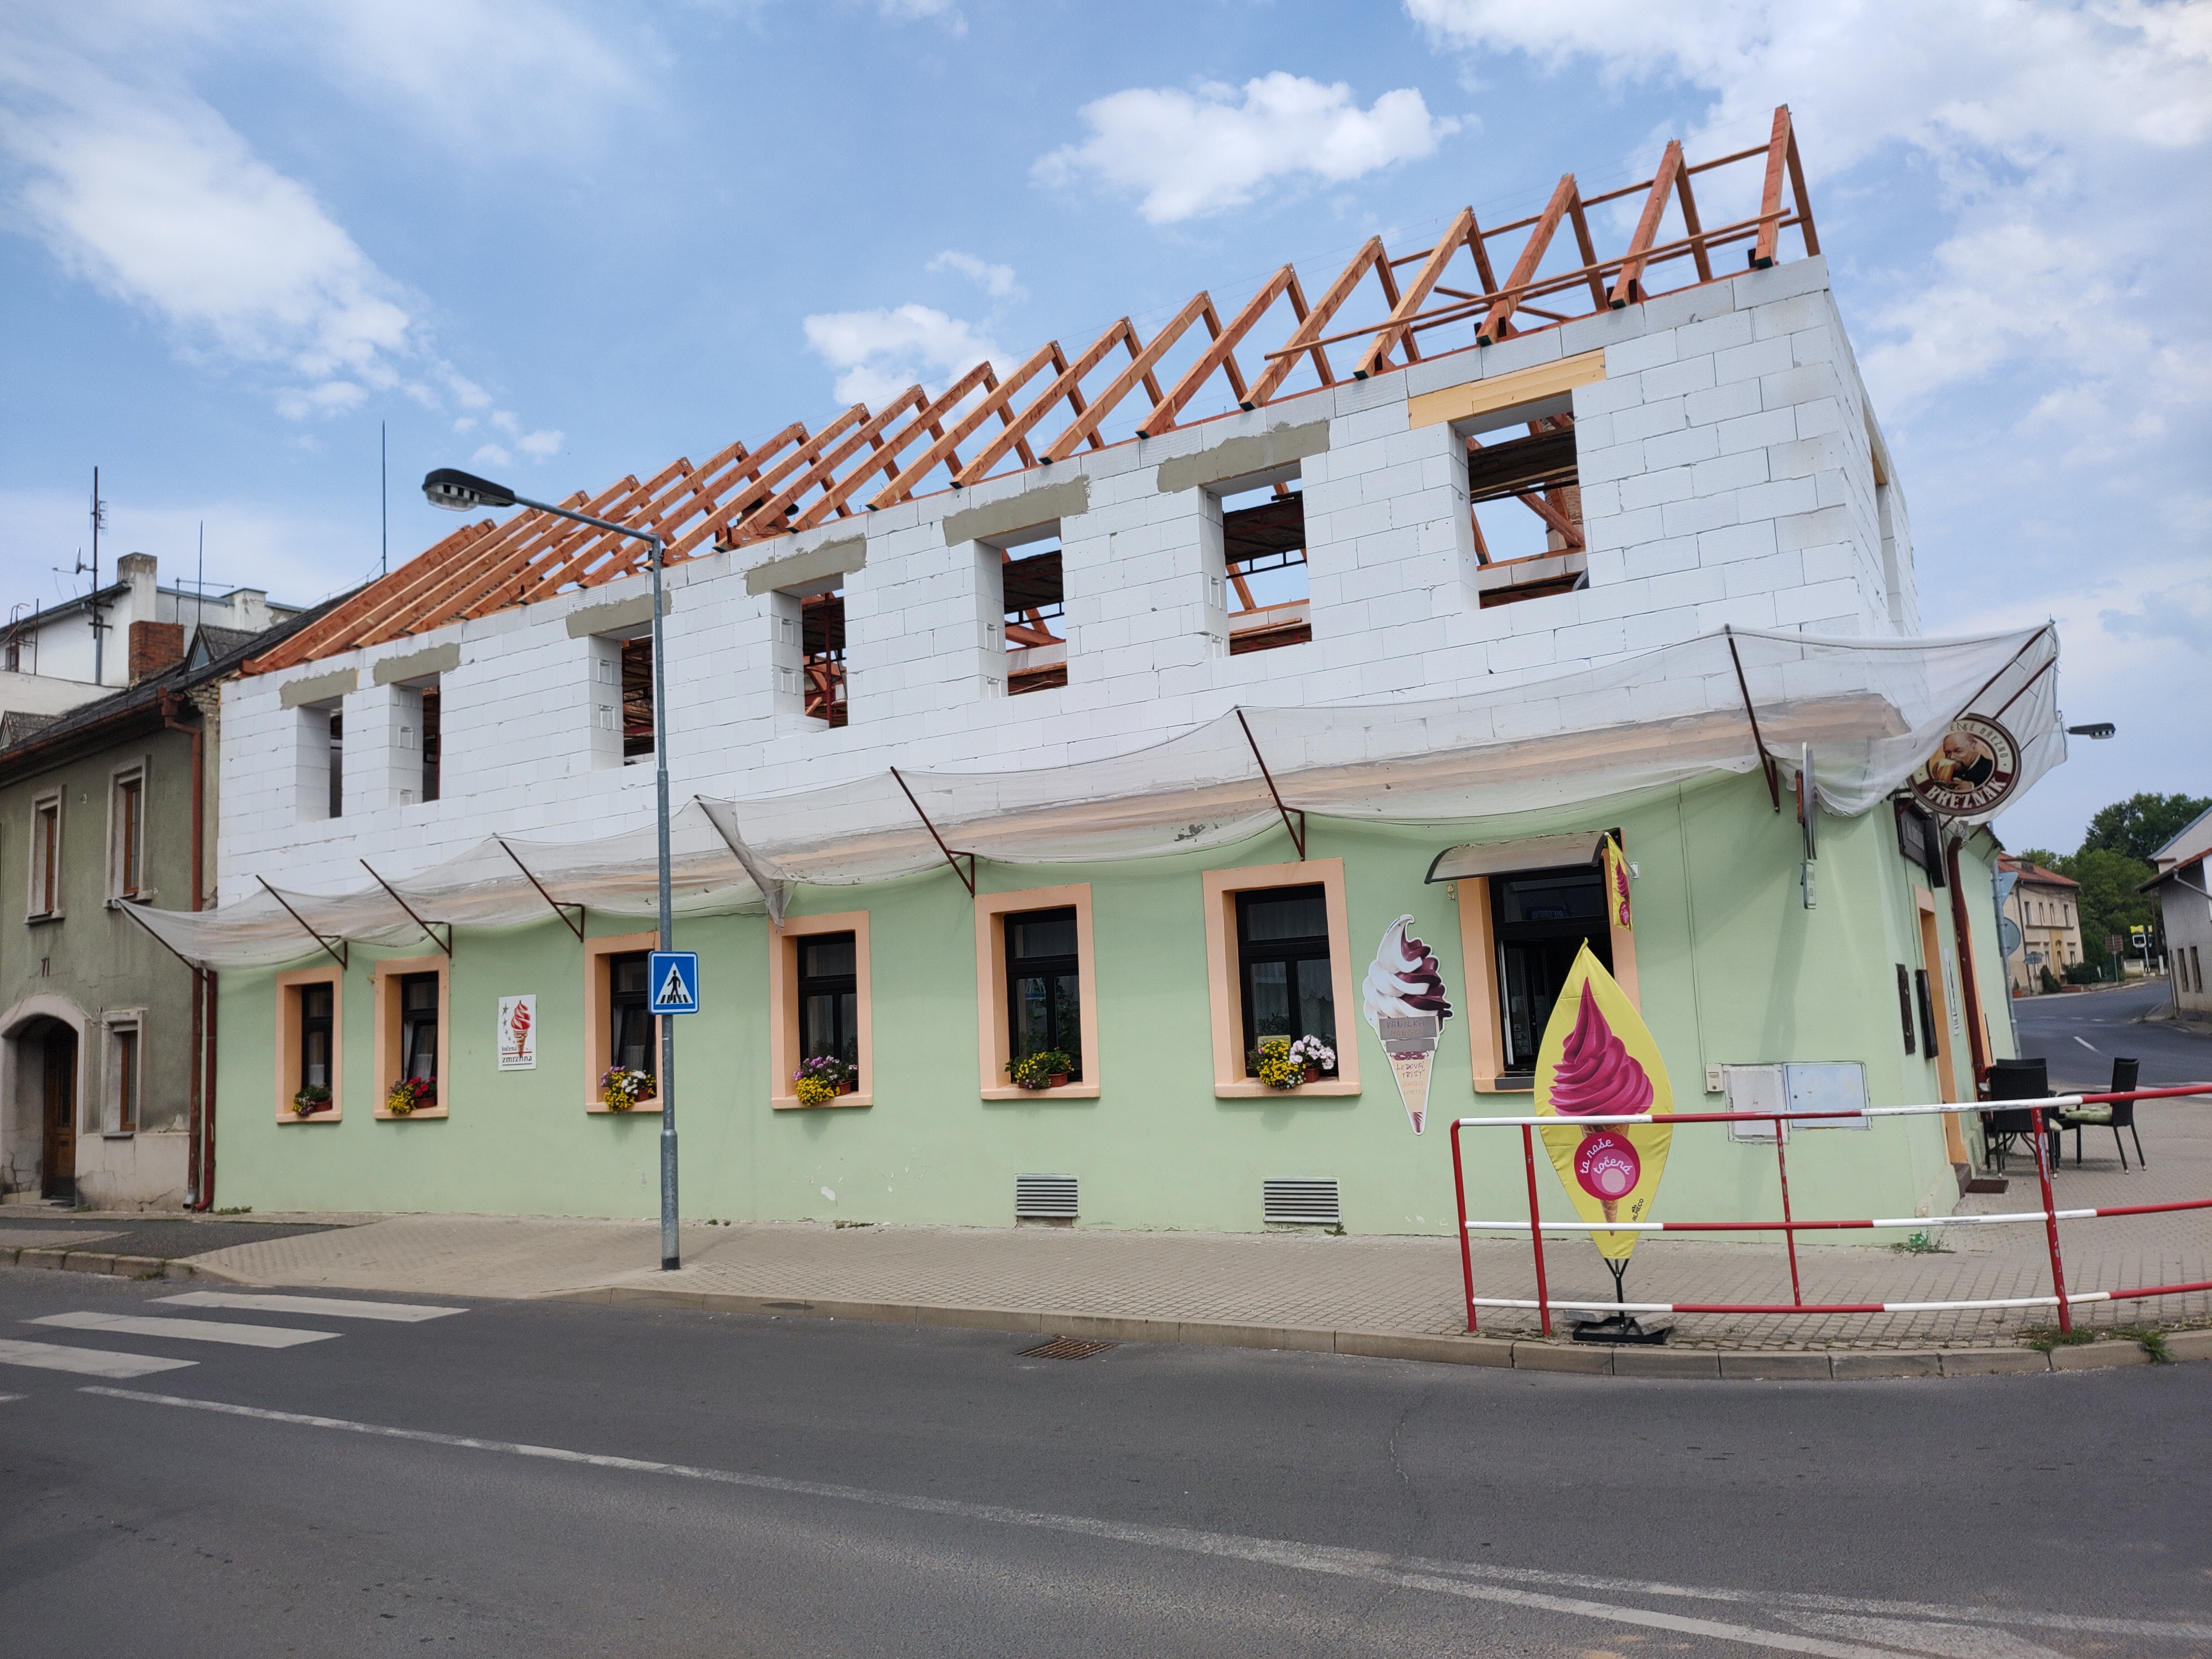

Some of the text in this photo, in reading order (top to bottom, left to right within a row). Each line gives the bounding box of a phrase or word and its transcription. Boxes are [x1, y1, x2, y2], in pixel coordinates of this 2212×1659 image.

[1950, 722, 2008, 758] ELKÉ BŘEZNO
[1925, 776, 2007, 809] BŘEZŇÁK
[1386, 1019, 1425, 1029] VANILKA
[1396, 1061, 1425, 1071] LEDOVÁ
[1580, 1138, 1614, 1173] ta naše
[1593, 1156, 1633, 1175] točená
